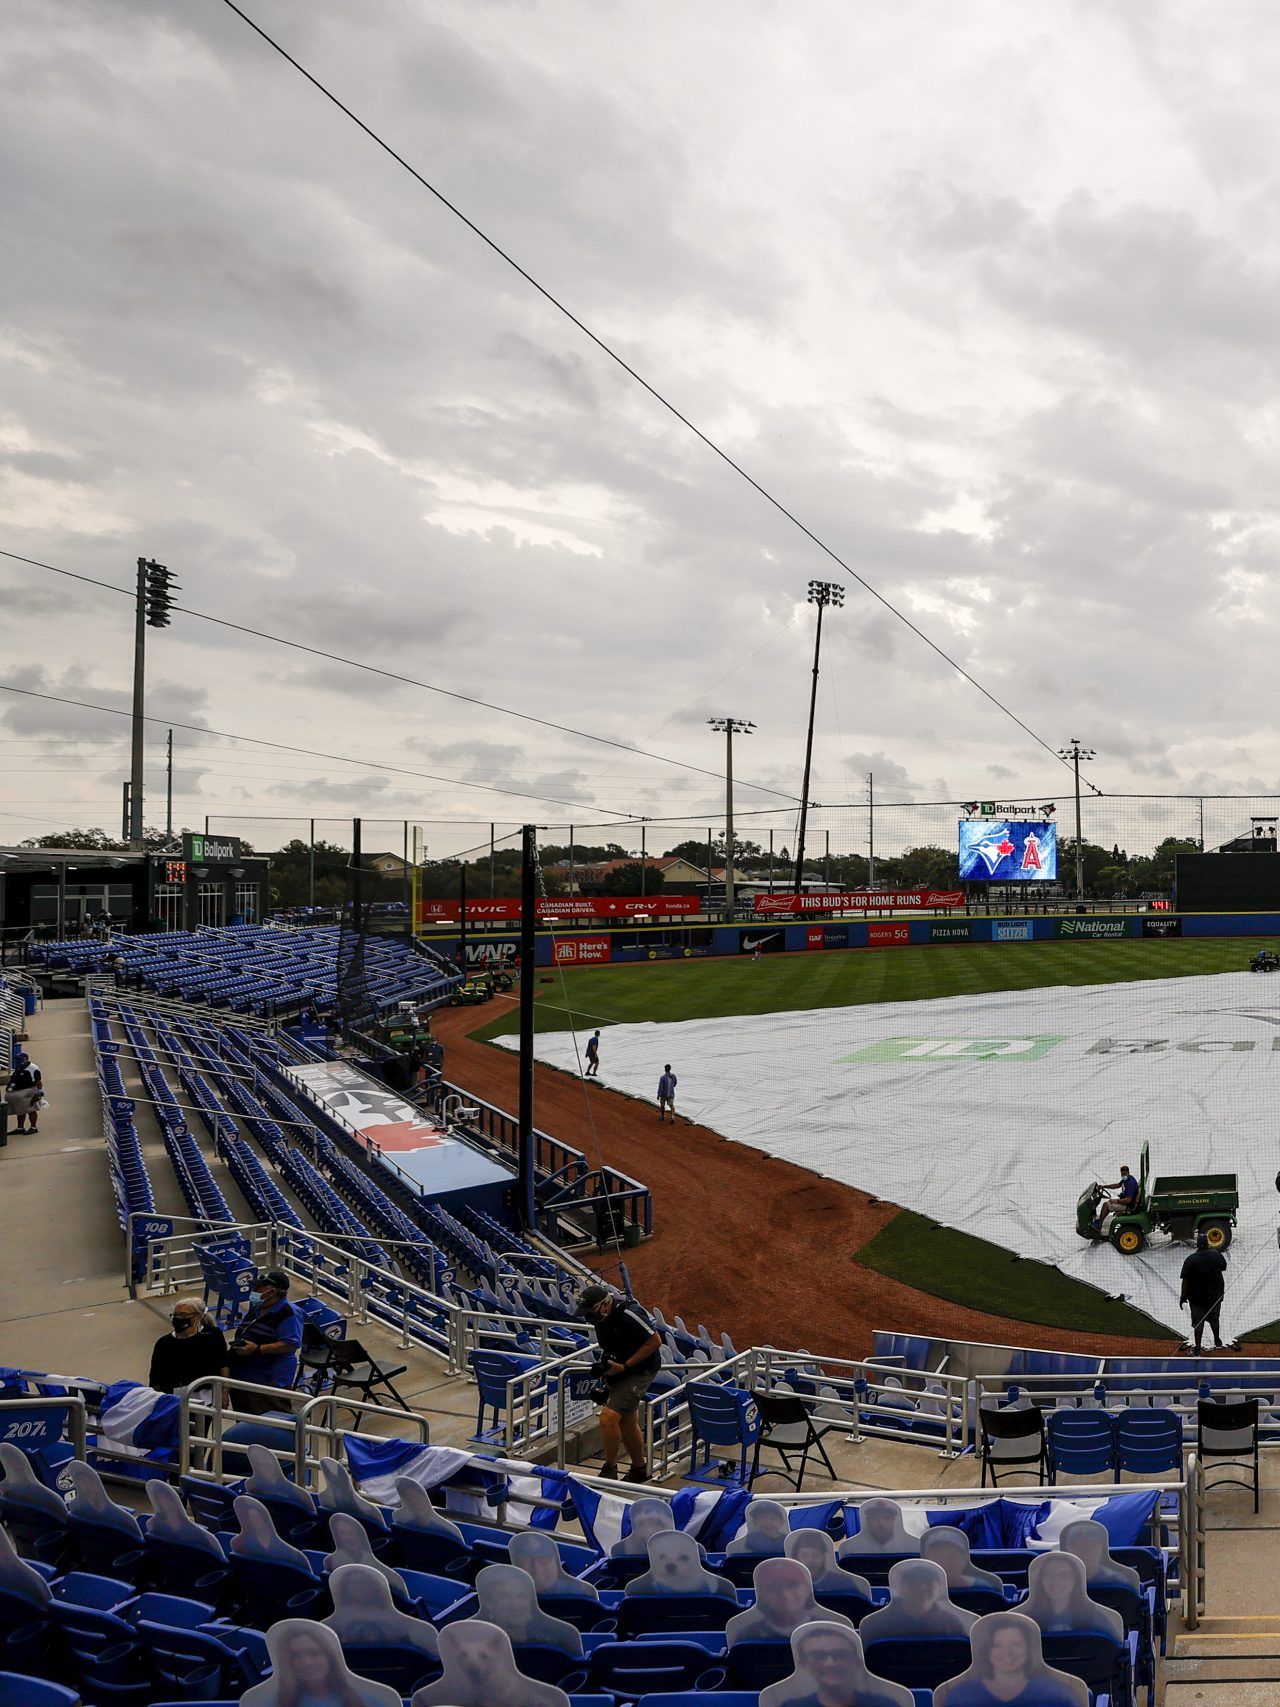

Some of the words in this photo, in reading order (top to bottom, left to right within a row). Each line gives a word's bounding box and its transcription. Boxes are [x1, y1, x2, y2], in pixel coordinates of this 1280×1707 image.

[983, 804, 994, 813] TD
[996, 804, 1036, 815] Ballpark
[193, 840, 202, 856] TD
[204, 841, 234, 860] Ballpark
[761, 899, 792, 907] Budweiser
[800, 896, 821, 908] THIS
[823, 896, 849, 907] BUD'S
[850, 896, 868, 907] FOR
[869, 895, 895, 906] HOME
[897, 894, 922, 905] RUNS
[458, 905, 507, 913] CIVIC
[894, 929, 908, 939] 5G
[998, 927, 1028, 939] SELTZER
[579, 941, 608, 950] Here's
[465, 943, 517, 962] MNP
[579, 951, 603, 959] How.
[897, 1039, 1037, 1058] TD
[117, 1101, 132, 1109] 109
[145, 1222, 169, 1234] 108
[575, 1379, 599, 1395] 107
[3, 1420, 47, 1439] 207L
